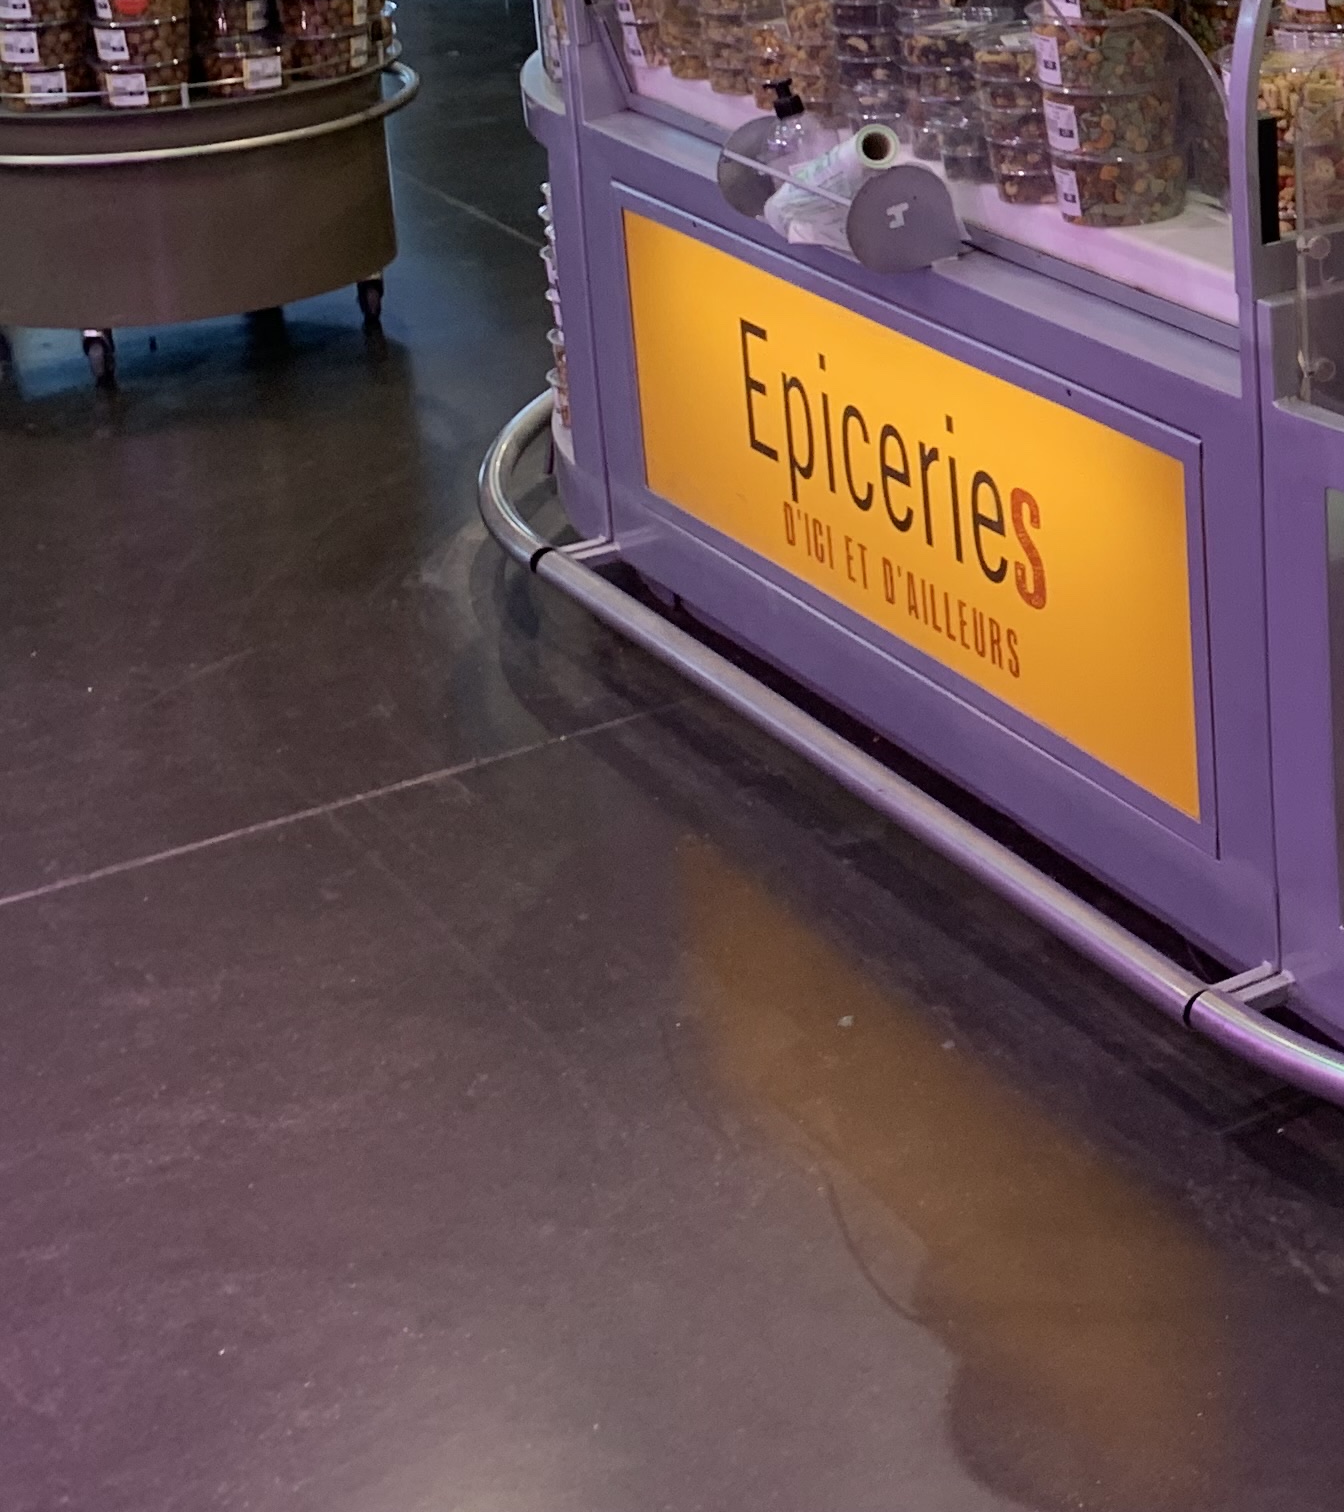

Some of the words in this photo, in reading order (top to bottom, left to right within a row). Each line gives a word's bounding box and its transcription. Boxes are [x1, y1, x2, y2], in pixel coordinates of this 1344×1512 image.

[740, 317, 1048, 611] Epiceries
[783, 501, 835, 570] D'ICI
[845, 536, 870, 591] ET
[883, 556, 1021, 680] D'AILLEURS
